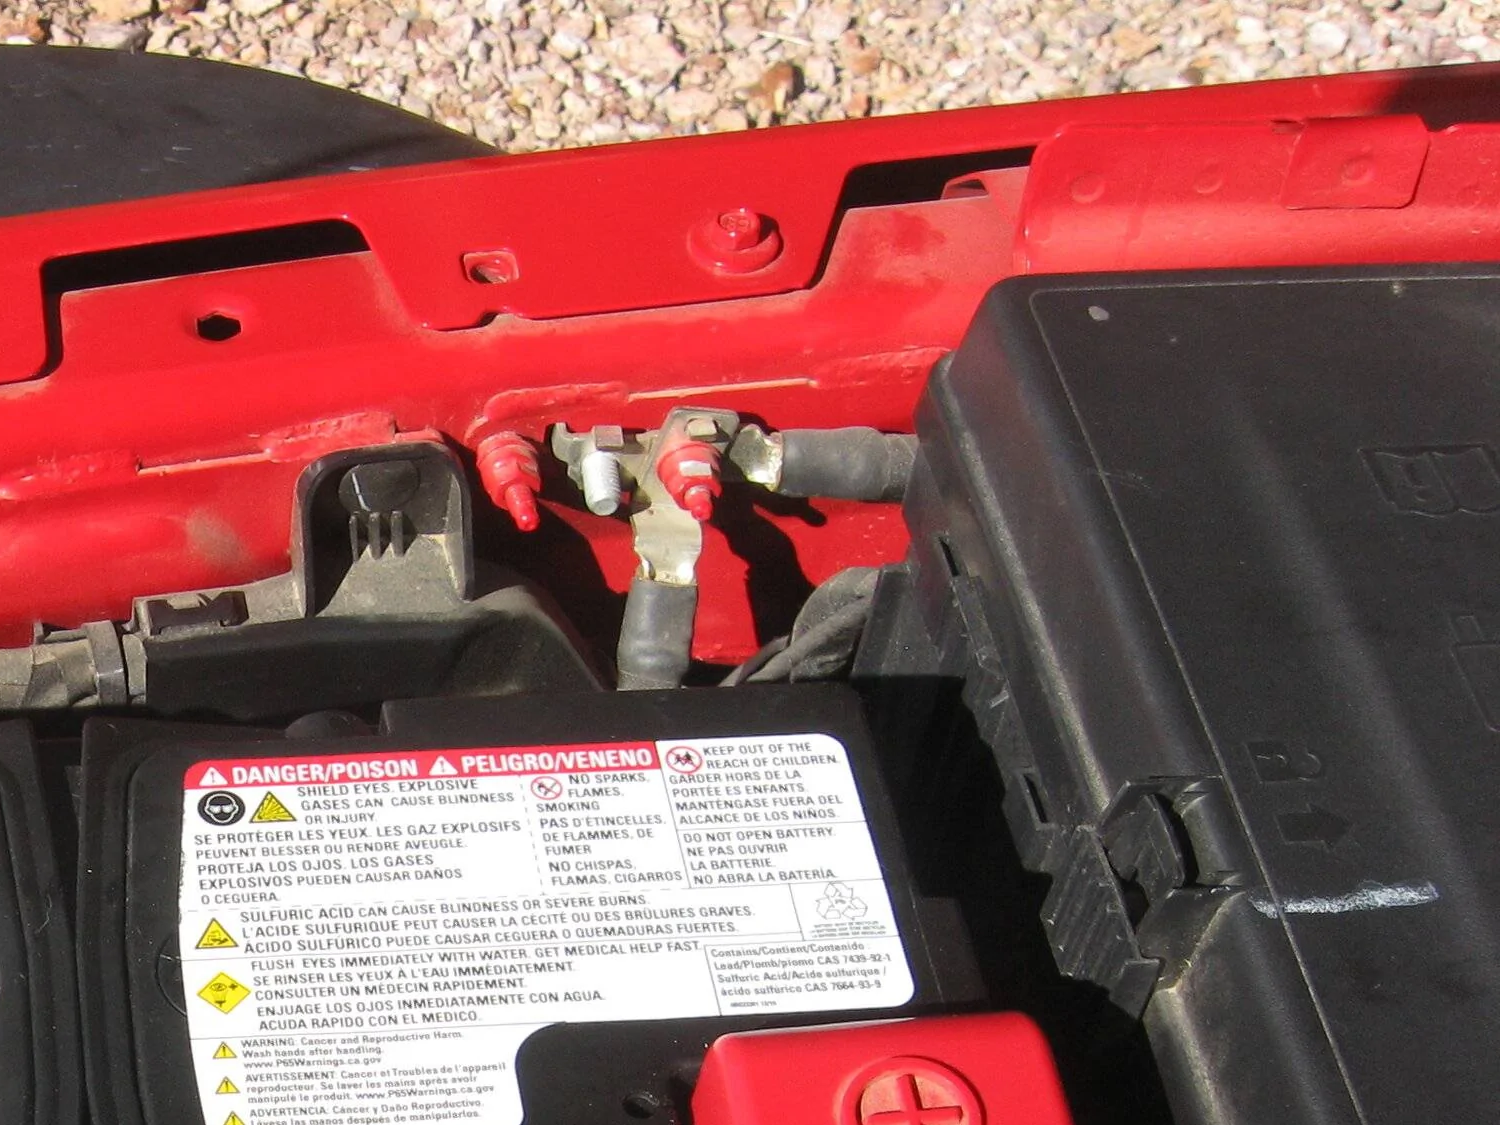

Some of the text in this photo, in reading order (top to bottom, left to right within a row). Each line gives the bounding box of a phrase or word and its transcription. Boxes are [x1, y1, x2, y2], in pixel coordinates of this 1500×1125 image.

[703, 742, 812, 756] KEEP OUT OF THE
[462, 748, 652, 773] PELIGRO/VENENO
[232, 759, 418, 784] DANGER/POISON
[669, 770, 802, 784] GARDER HORS DE LA
[297, 785, 349, 797] SHIELD
[398, 780, 478, 792] EXPLOSIVE
[301, 792, 515, 810] GASES CAN CAUSE BLINDNESS
[536, 801, 600, 813] SMOKING
[680, 813, 739, 824] ALCANCE
[744, 812, 760, 822] DE
[764, 811, 789, 821] LOS
[194, 835, 214, 846] SE
[299, 830, 324, 841] LES
[377, 826, 402, 837] LES
[408, 825, 436, 836] GAZ
[441, 821, 521, 835] EXPLOSIFS
[683, 834, 702, 843] DO
[706, 832, 731, 842] NOT
[736, 830, 772, 841] OPEN
[195, 847, 256, 860] PEUVENT
[262, 845, 320, 857] BLESSER
[324, 844, 343, 855] OU
[347, 842, 399, 854] RENDRE
[545, 844, 591, 856] FUMER
[687, 843, 788, 856] NE PAS OUVRIR
[198, 862, 265, 876] PROTEJA
[269, 861, 298, 872] LOS
[351, 857, 379, 868] LOS
[384, 854, 434, 867] GASES
[199, 868, 462, 890] EXPLOSIVOS PUEDEN CAUSAR DAÑOS
[240, 909, 314, 922] SULFURIC
[318, 908, 354, 919] ACID
[358, 906, 388, 917] CAN
[391, 904, 436, 916] CAUSE
[440, 901, 518, 914] BLINDNESS
[522, 900, 541, 910] OR
[545, 897, 595, 909] SEVERE
[251, 960, 294, 971] FLUSH
[303, 958, 336, 969] EYES
[340, 953, 433, 967] IMMEDIATELY
[439, 951, 474, 962] WITH
[535, 948, 559, 958] GET
[564, 945, 625, 957] MEDICAL
[630, 943, 662, 954] HELP
[805, 982, 828, 992] CAS
[257, 1004, 322, 1017] ENJUAGE
[327, 1002, 352, 1014] LOS
[357, 1001, 393, 1012] OJOS
[398, 994, 525, 1010] INMEDIATAMENTE
[529, 993, 558, 1004] CON
